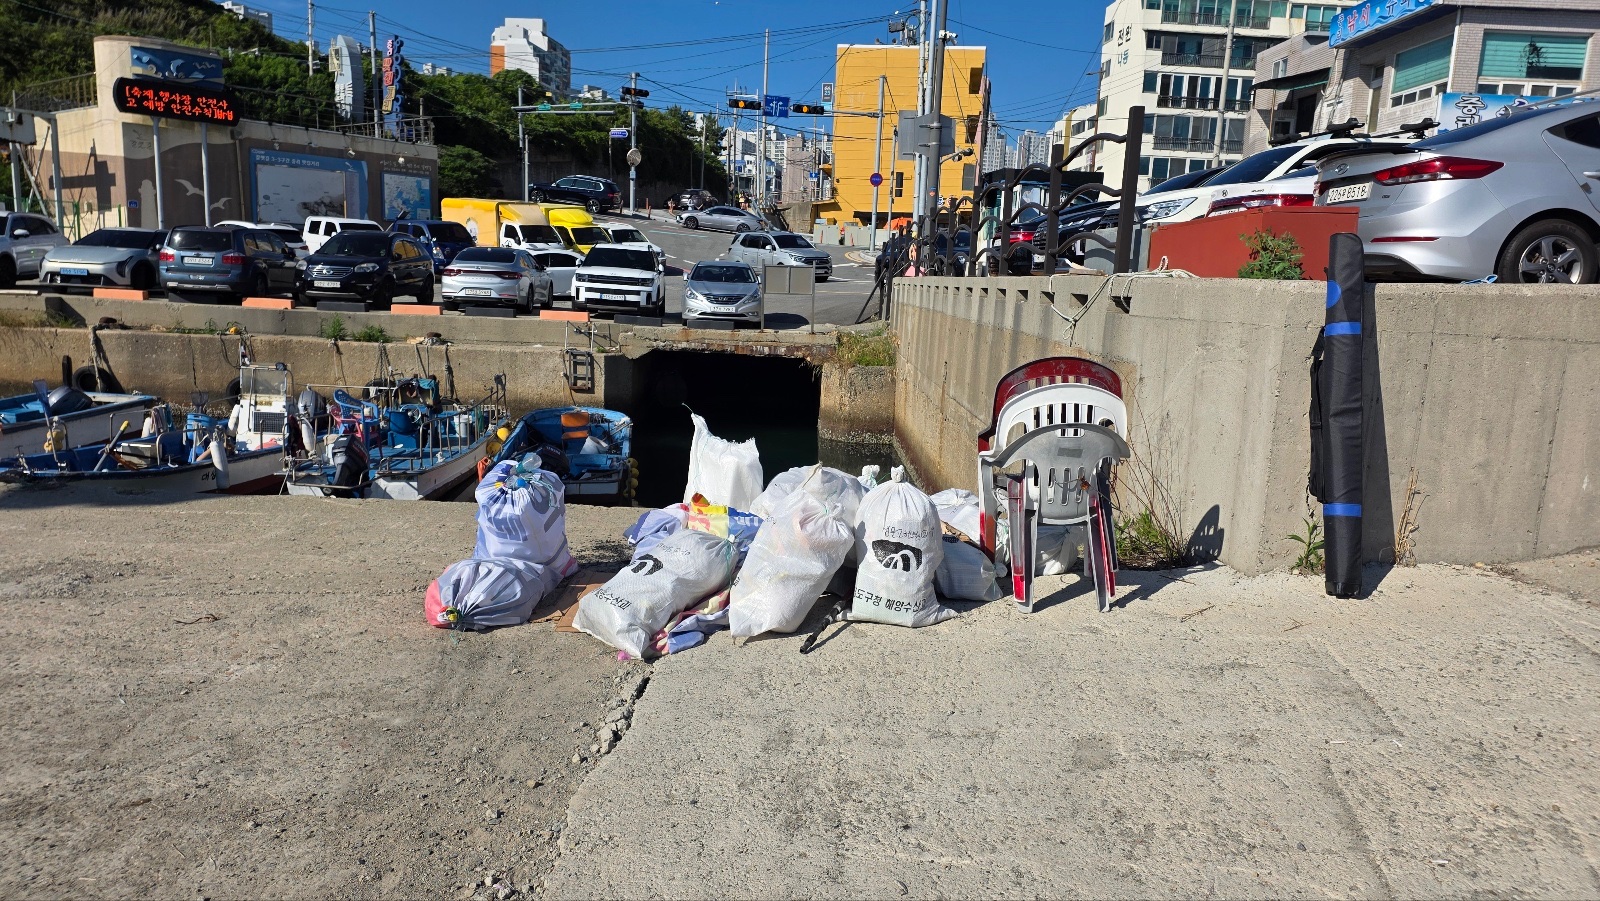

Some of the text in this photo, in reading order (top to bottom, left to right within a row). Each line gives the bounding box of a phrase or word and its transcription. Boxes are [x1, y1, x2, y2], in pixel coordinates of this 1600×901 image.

[126, 98, 137, 107] 고
[143, 100, 164, 112] 예방
[197, 96, 229, 109] 안전사
